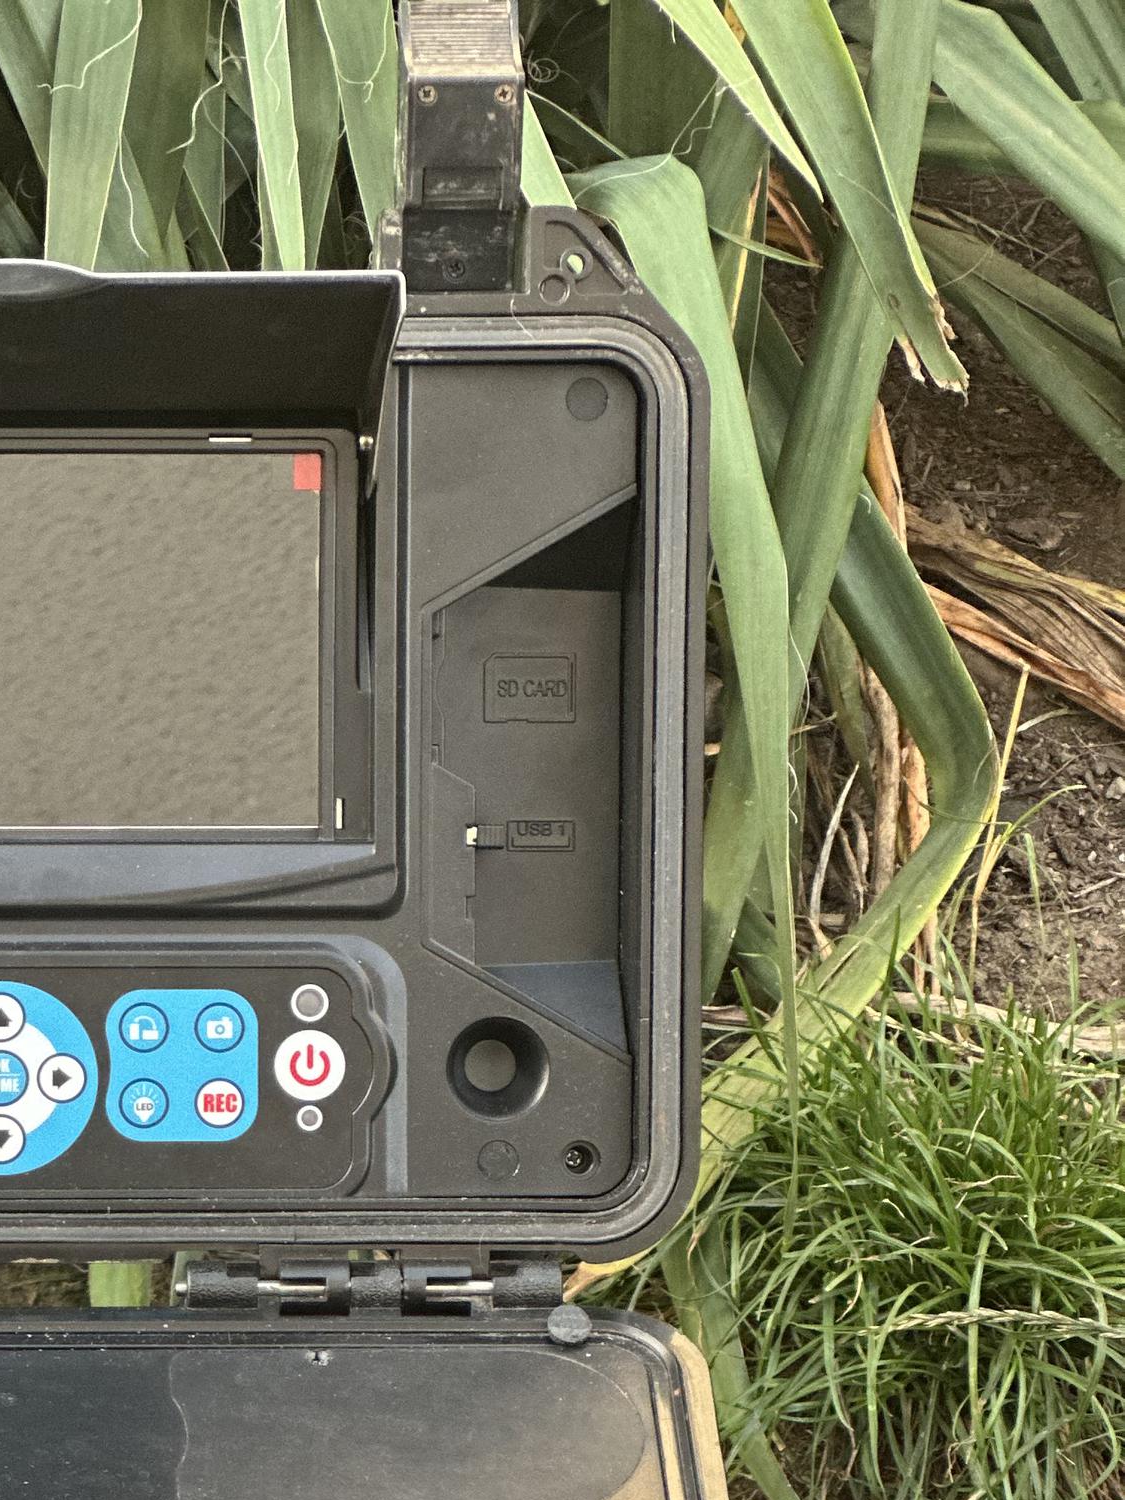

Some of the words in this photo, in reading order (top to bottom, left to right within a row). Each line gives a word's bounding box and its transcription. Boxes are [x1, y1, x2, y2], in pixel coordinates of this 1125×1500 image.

[498, 680, 519, 698] SD
[525, 680, 567, 698] CARD
[516, 823, 552, 836] USB
[135, 1102, 154, 1111] LED
[203, 1093, 238, 1113] REC
